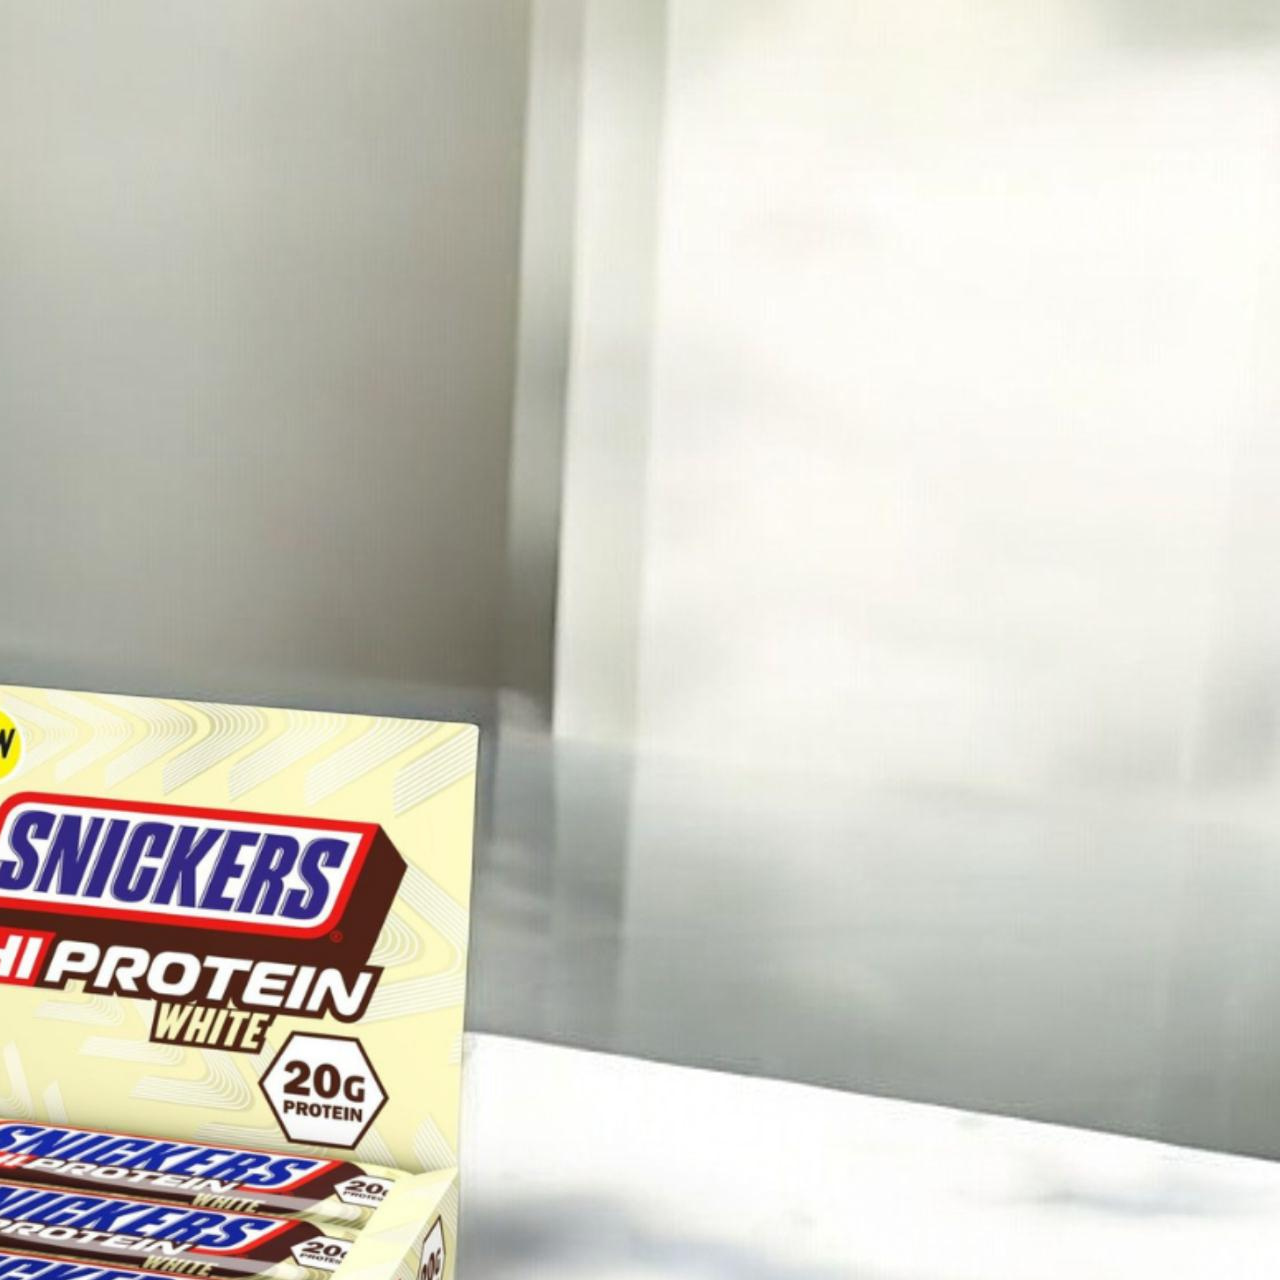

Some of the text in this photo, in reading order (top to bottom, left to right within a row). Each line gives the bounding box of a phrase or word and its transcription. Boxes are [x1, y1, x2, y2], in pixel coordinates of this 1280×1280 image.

[44, 941, 373, 1017] PROTEIN
[155, 1003, 270, 1051] WHITE
[283, 1061, 365, 1104] 20G
[283, 1101, 363, 1123] PROTEIN
[22, 1157, 239, 1193] PROTEIN
[190, 1193, 261, 1214] WHITE
[140, 1254, 217, 1277] WHITE
